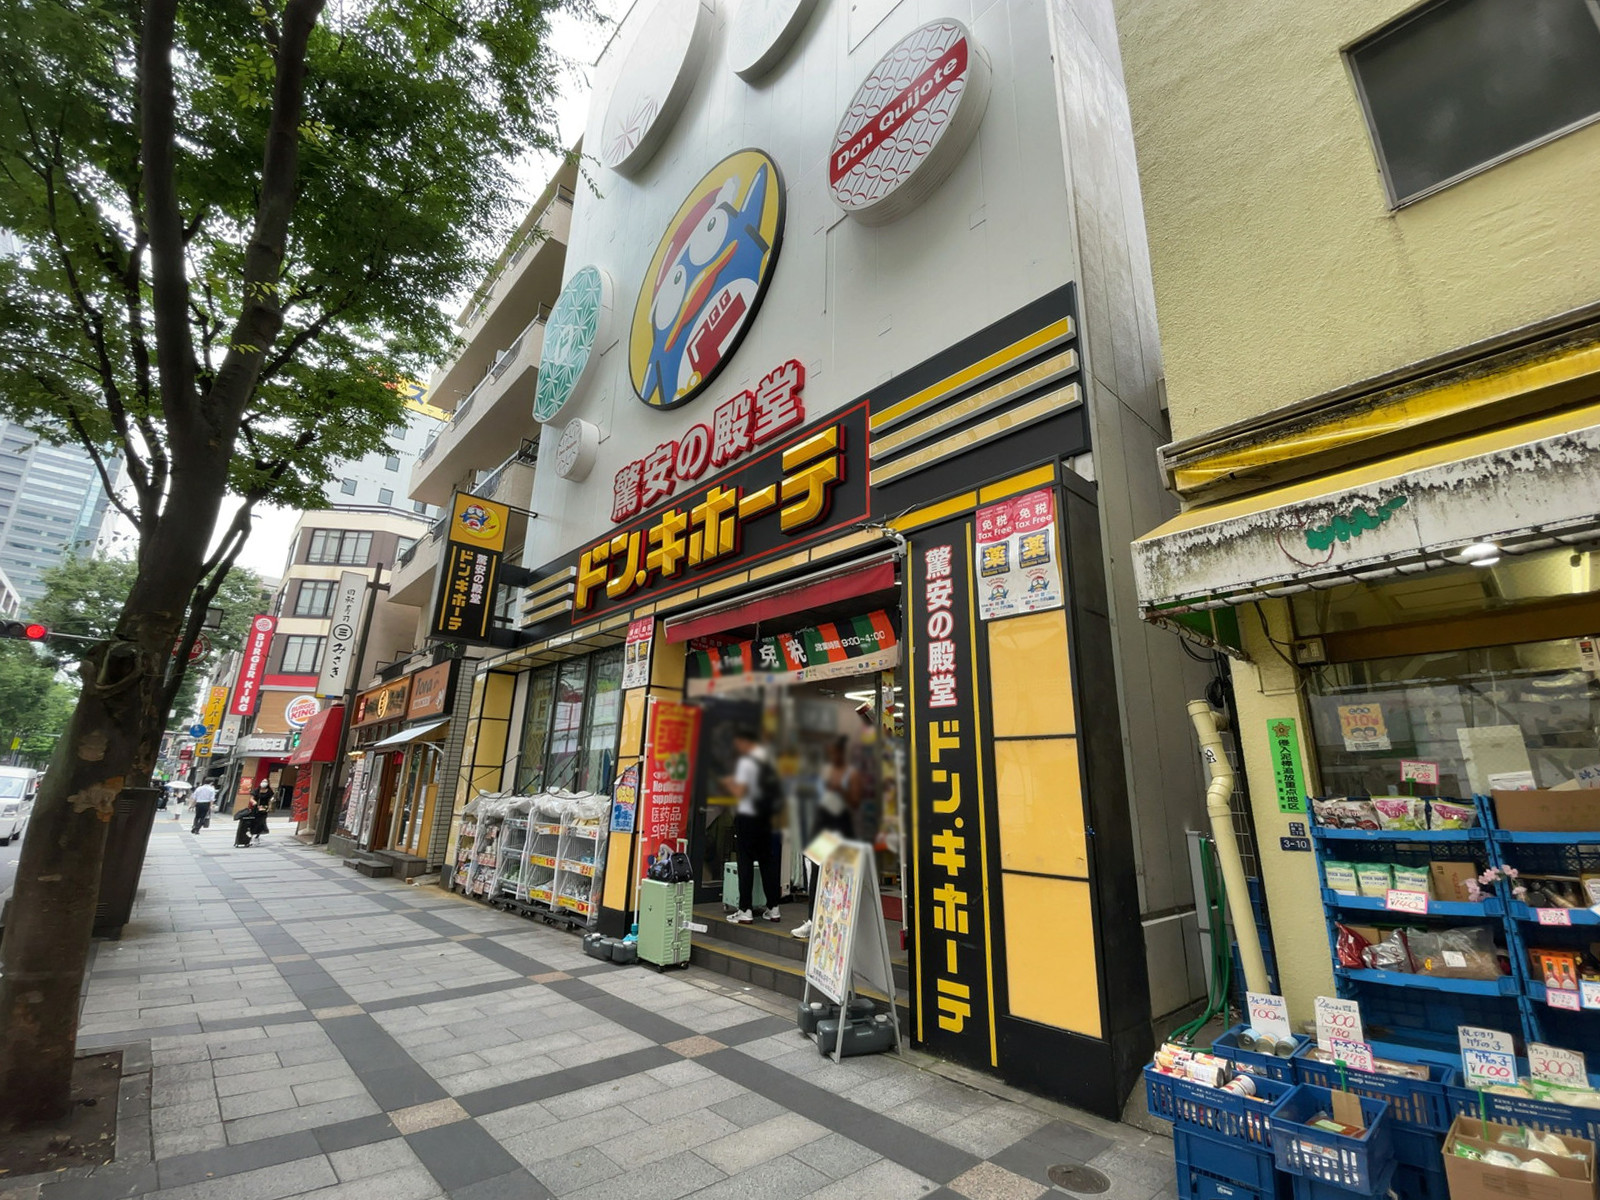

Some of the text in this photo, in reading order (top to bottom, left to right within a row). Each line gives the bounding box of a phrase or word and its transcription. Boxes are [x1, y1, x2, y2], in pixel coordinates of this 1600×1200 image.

[836, 57, 958, 171] Don Quijote
[611, 360, 805, 522] 驚安の殿堂
[1020, 502, 1047, 520] 免税
[982, 514, 1008, 532] 免税
[1015, 513, 1052, 530] Tax Free
[978, 525, 1013, 540] Tax Free
[924, 544, 957, 708] 驚安の殿堂
[329, 642, 347, 679] みさき
[759, 639, 808, 669] 免税
[238, 633, 266, 712] BURGER KING
[290, 708, 316, 719] KING
[291, 702, 316, 714] BURGER
[1283, 840, 1307, 848] 3-10
[1533, 1057, 1575, 1077] 300
